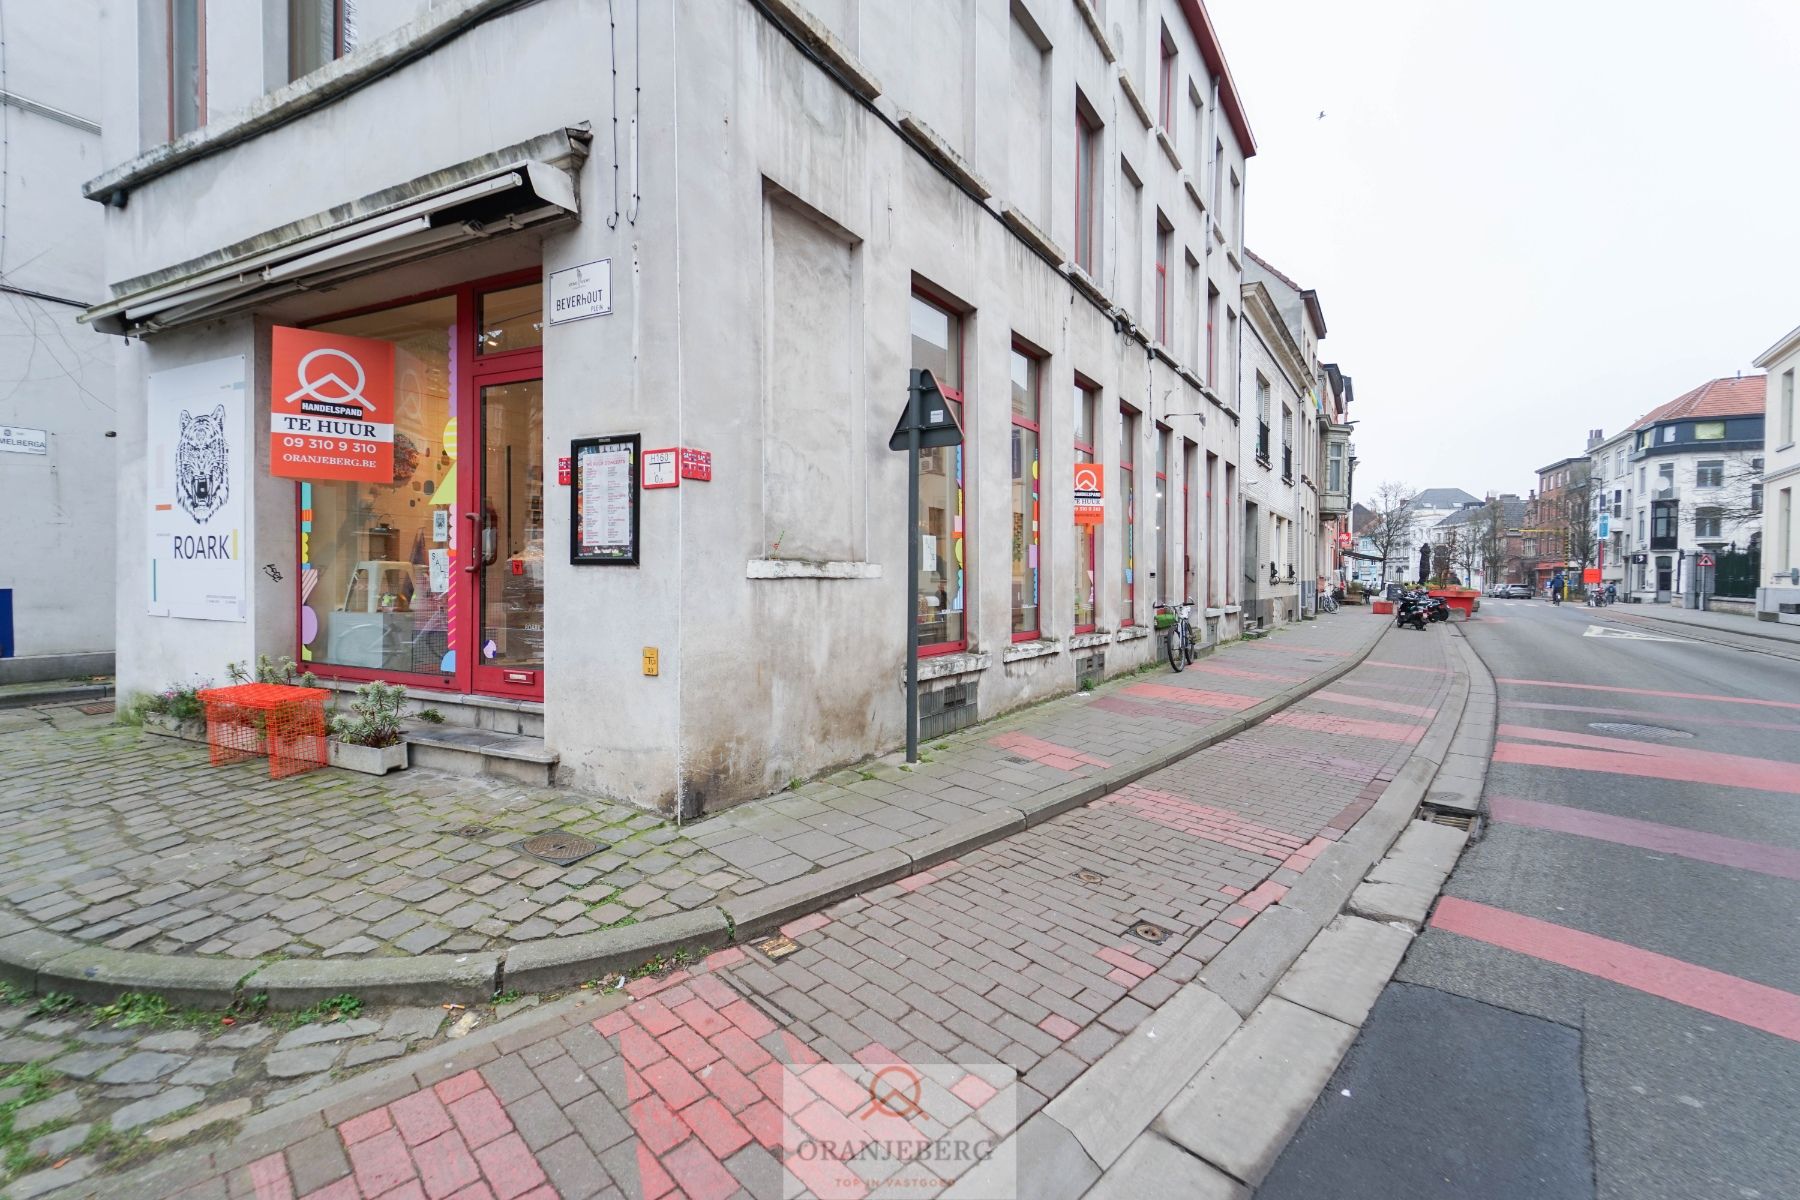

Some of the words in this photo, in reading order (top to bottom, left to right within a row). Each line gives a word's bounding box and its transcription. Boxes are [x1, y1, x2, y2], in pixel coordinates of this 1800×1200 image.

[302, 402, 363, 417] HANDELSPAND
[284, 416, 311, 432] TE
[317, 419, 377, 438] HUUR
[283, 436, 304, 448] 09
[308, 438, 334, 450] 310
[338, 441, 348, 452] 9
[352, 442, 377, 454] 310
[283, 453, 377, 468] ORANJEBERG.BE
[174, 535, 230, 560] ROARK
